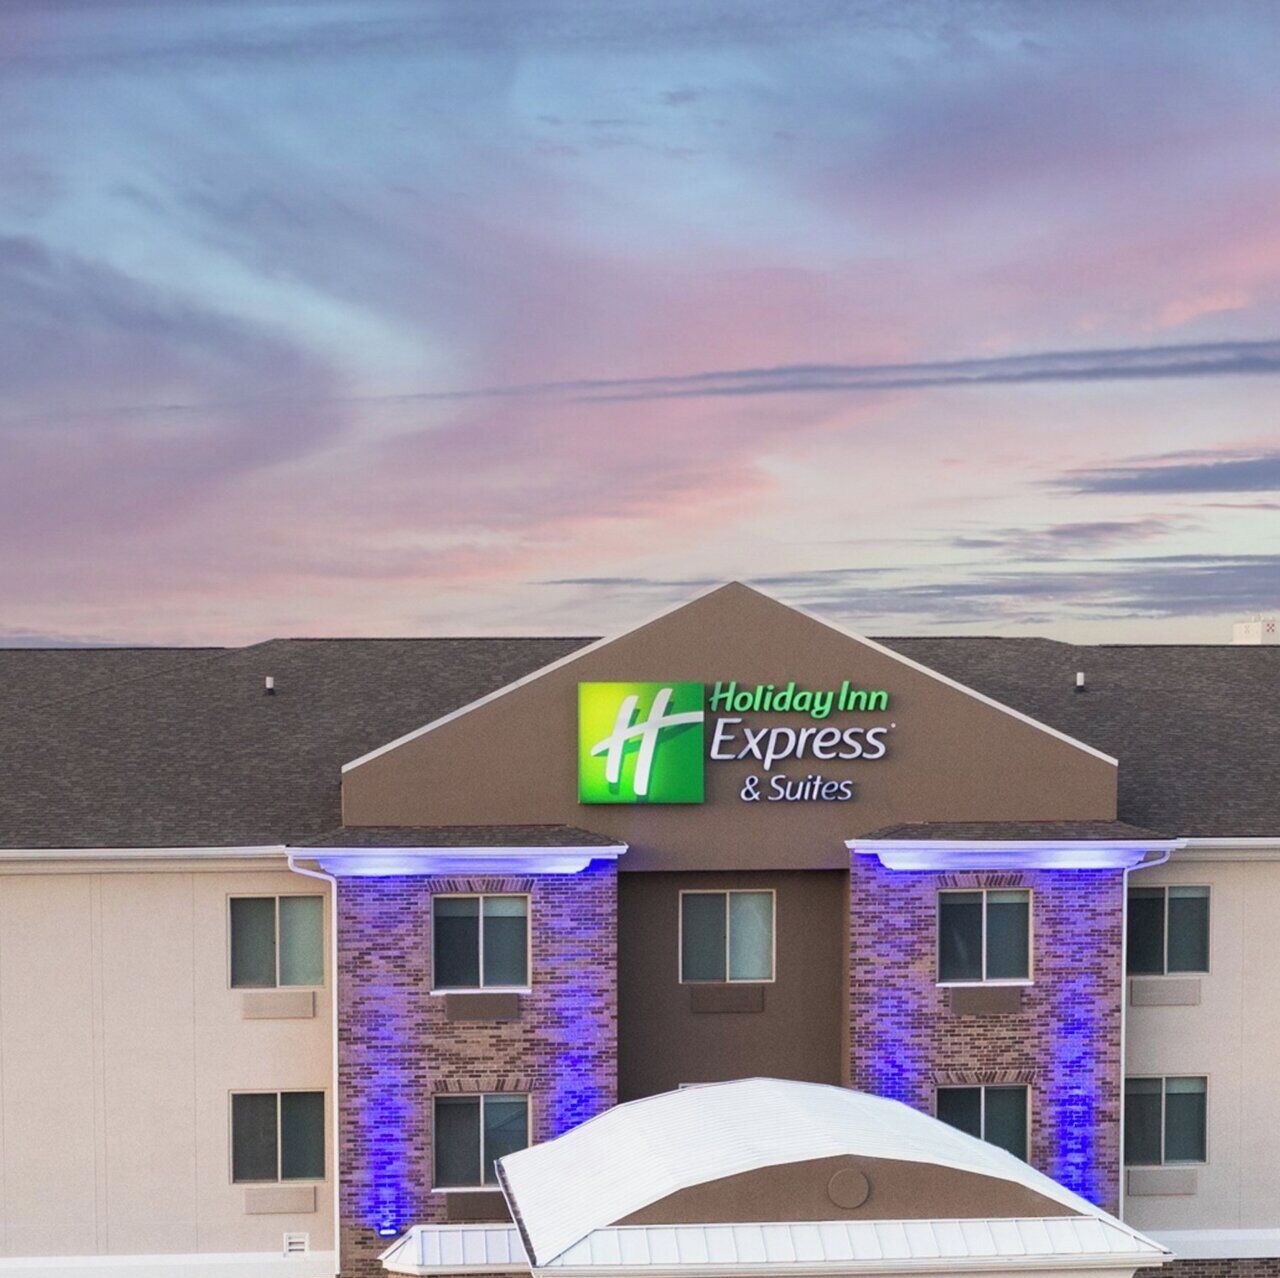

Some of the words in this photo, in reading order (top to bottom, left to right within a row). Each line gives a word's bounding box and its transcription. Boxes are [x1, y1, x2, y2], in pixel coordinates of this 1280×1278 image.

[710, 681, 834, 719] Holiday
[838, 681, 888, 711] Inn
[710, 717, 888, 771] Express
[740, 775, 761, 801] &
[768, 774, 853, 801] Suites
